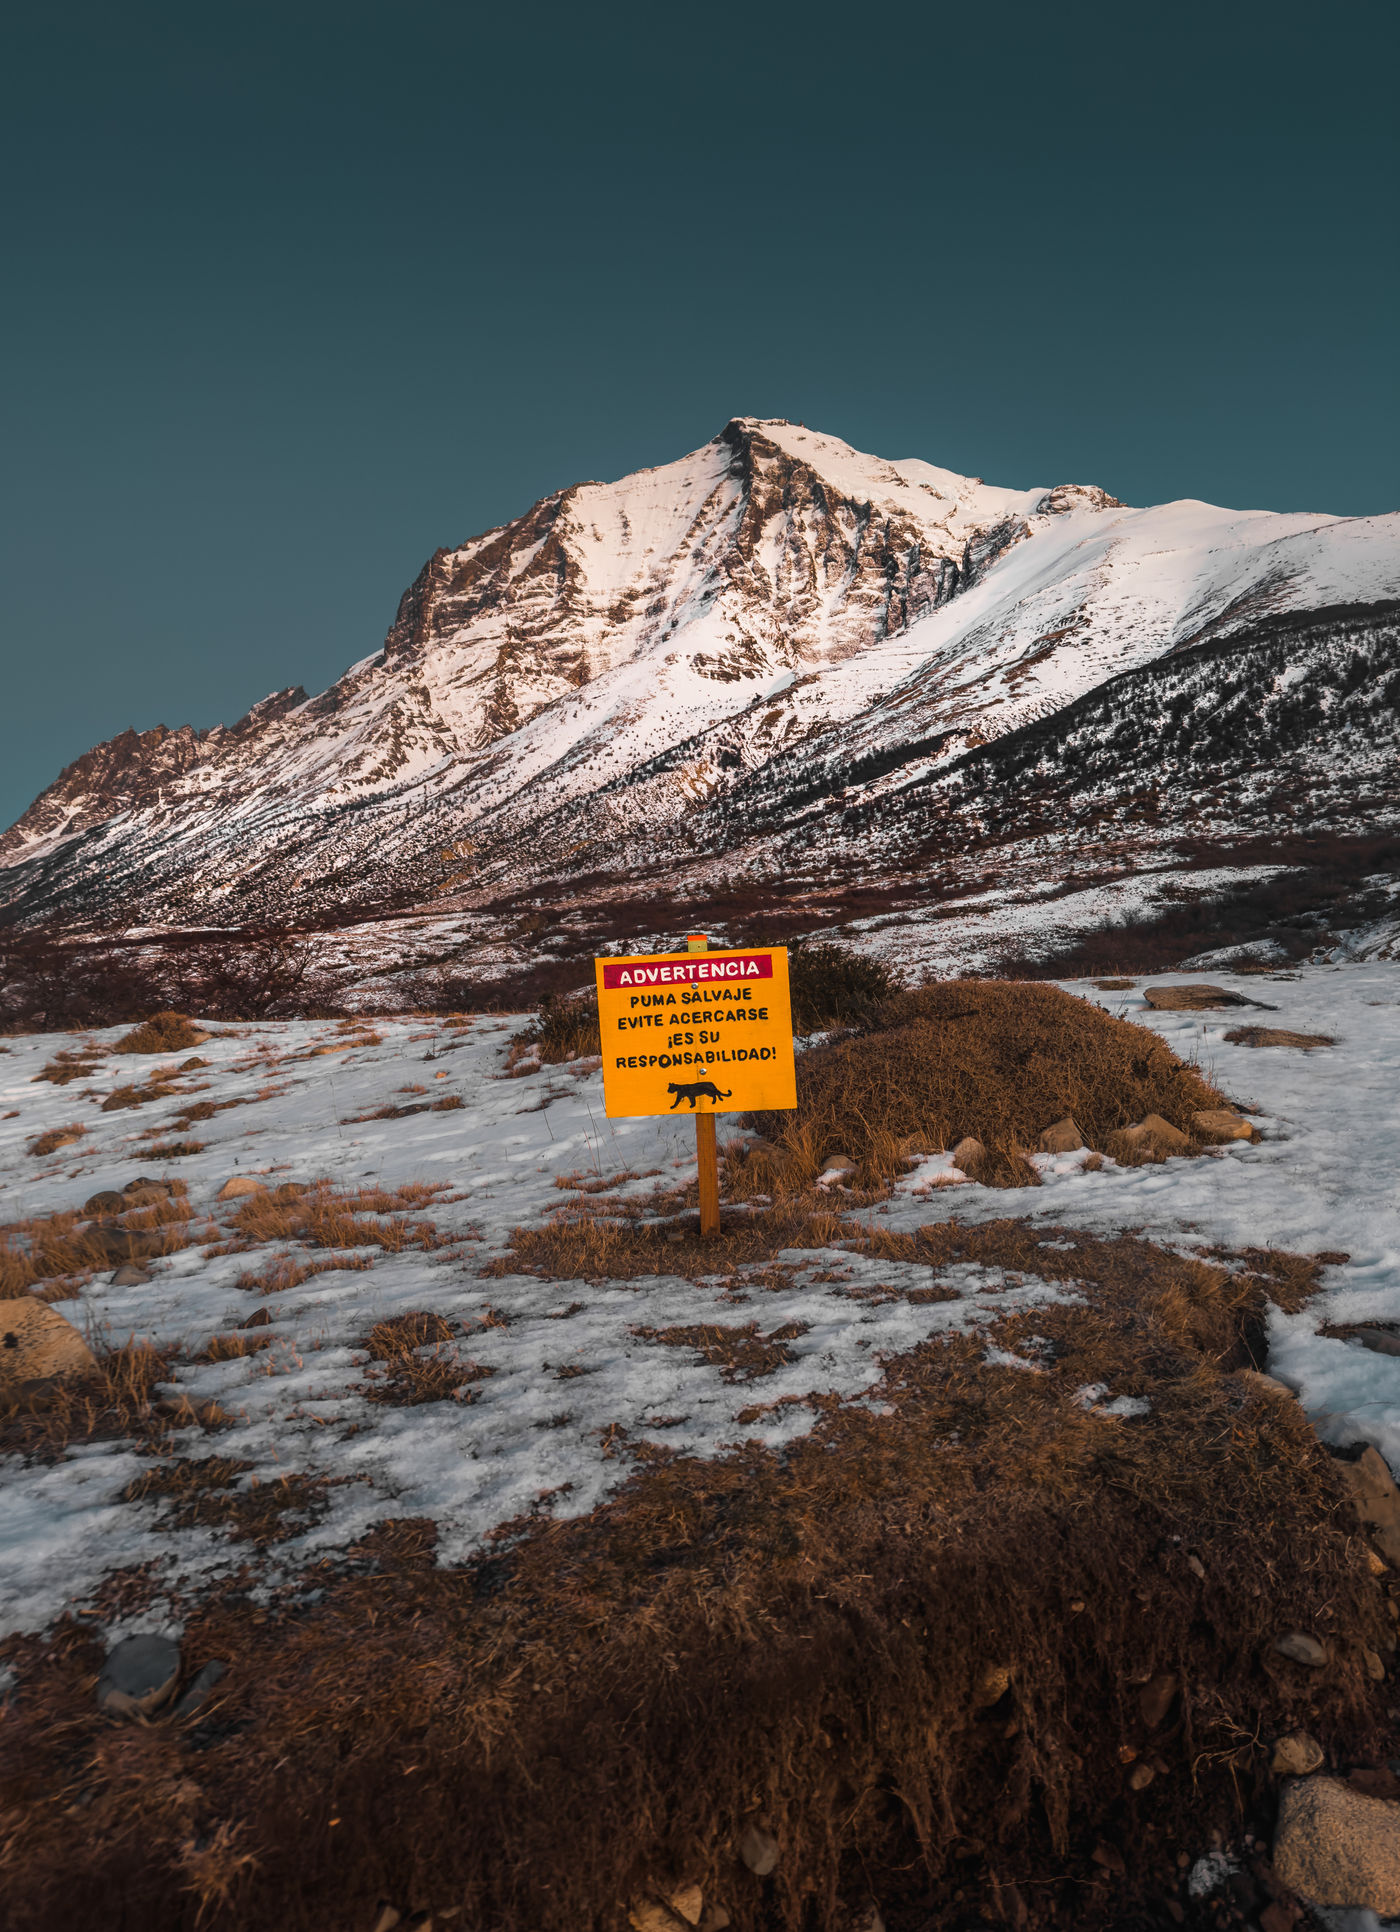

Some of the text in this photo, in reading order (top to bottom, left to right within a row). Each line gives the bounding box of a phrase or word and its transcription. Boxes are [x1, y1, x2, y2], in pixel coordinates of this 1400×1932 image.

[620, 960, 760, 985] ADVERTENCIA
[630, 987, 752, 1009] PUMA SALVAJE
[618, 1007, 769, 1030] EVITE ACERCARSE
[667, 1030, 720, 1049] ¡ES SU
[616, 1046, 777, 1069] RESPONSABILIDAD!
